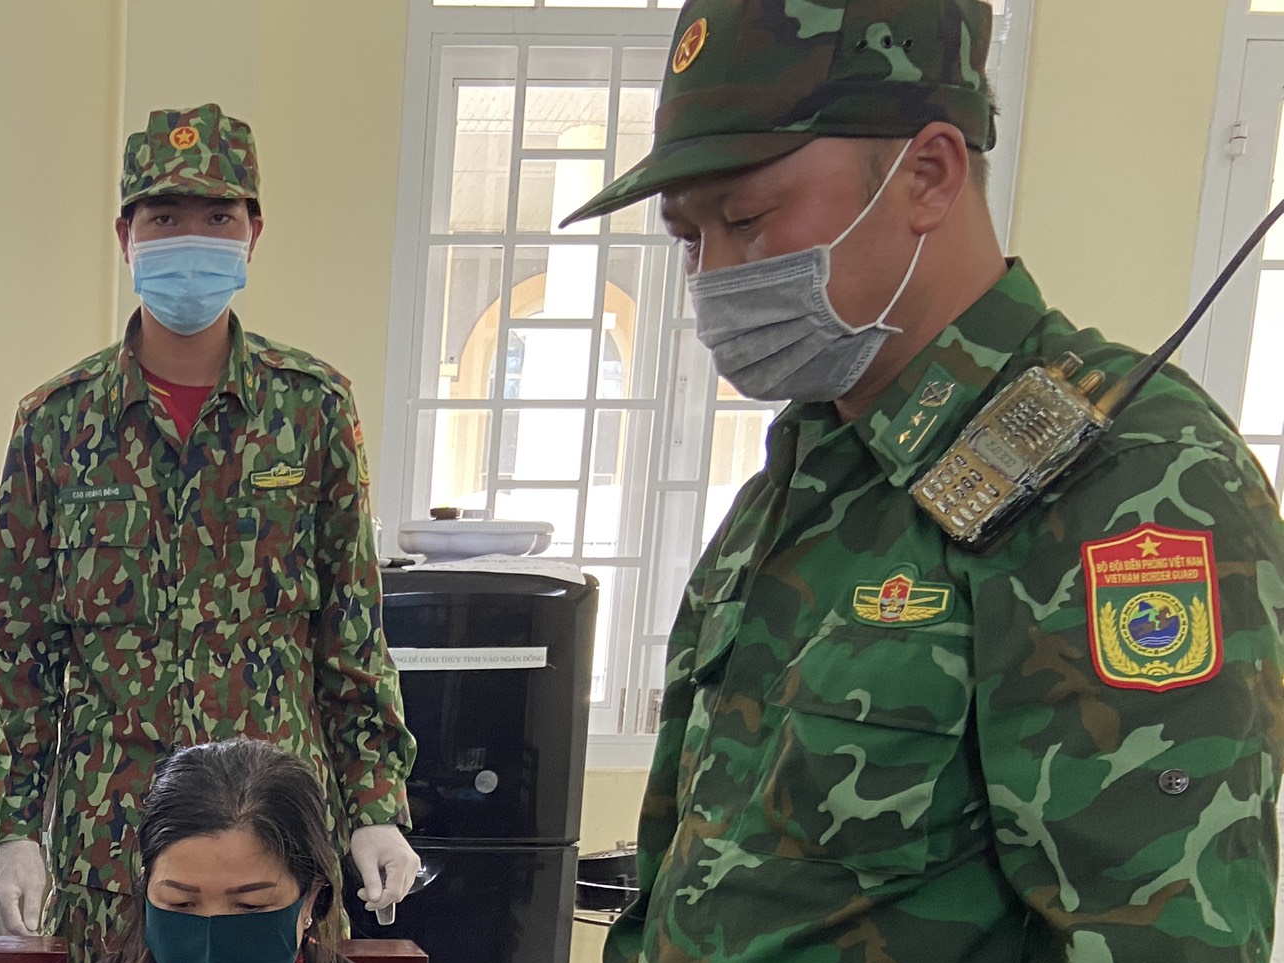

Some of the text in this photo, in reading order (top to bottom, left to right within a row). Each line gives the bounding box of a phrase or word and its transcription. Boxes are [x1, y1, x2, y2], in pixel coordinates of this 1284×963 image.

[1096, 555, 1203, 573] BỘ ĐỘI BIÊN PHÒNG VIỆT NAM
[1104, 569, 1199, 584] VIETNAM BORDER GUARD
